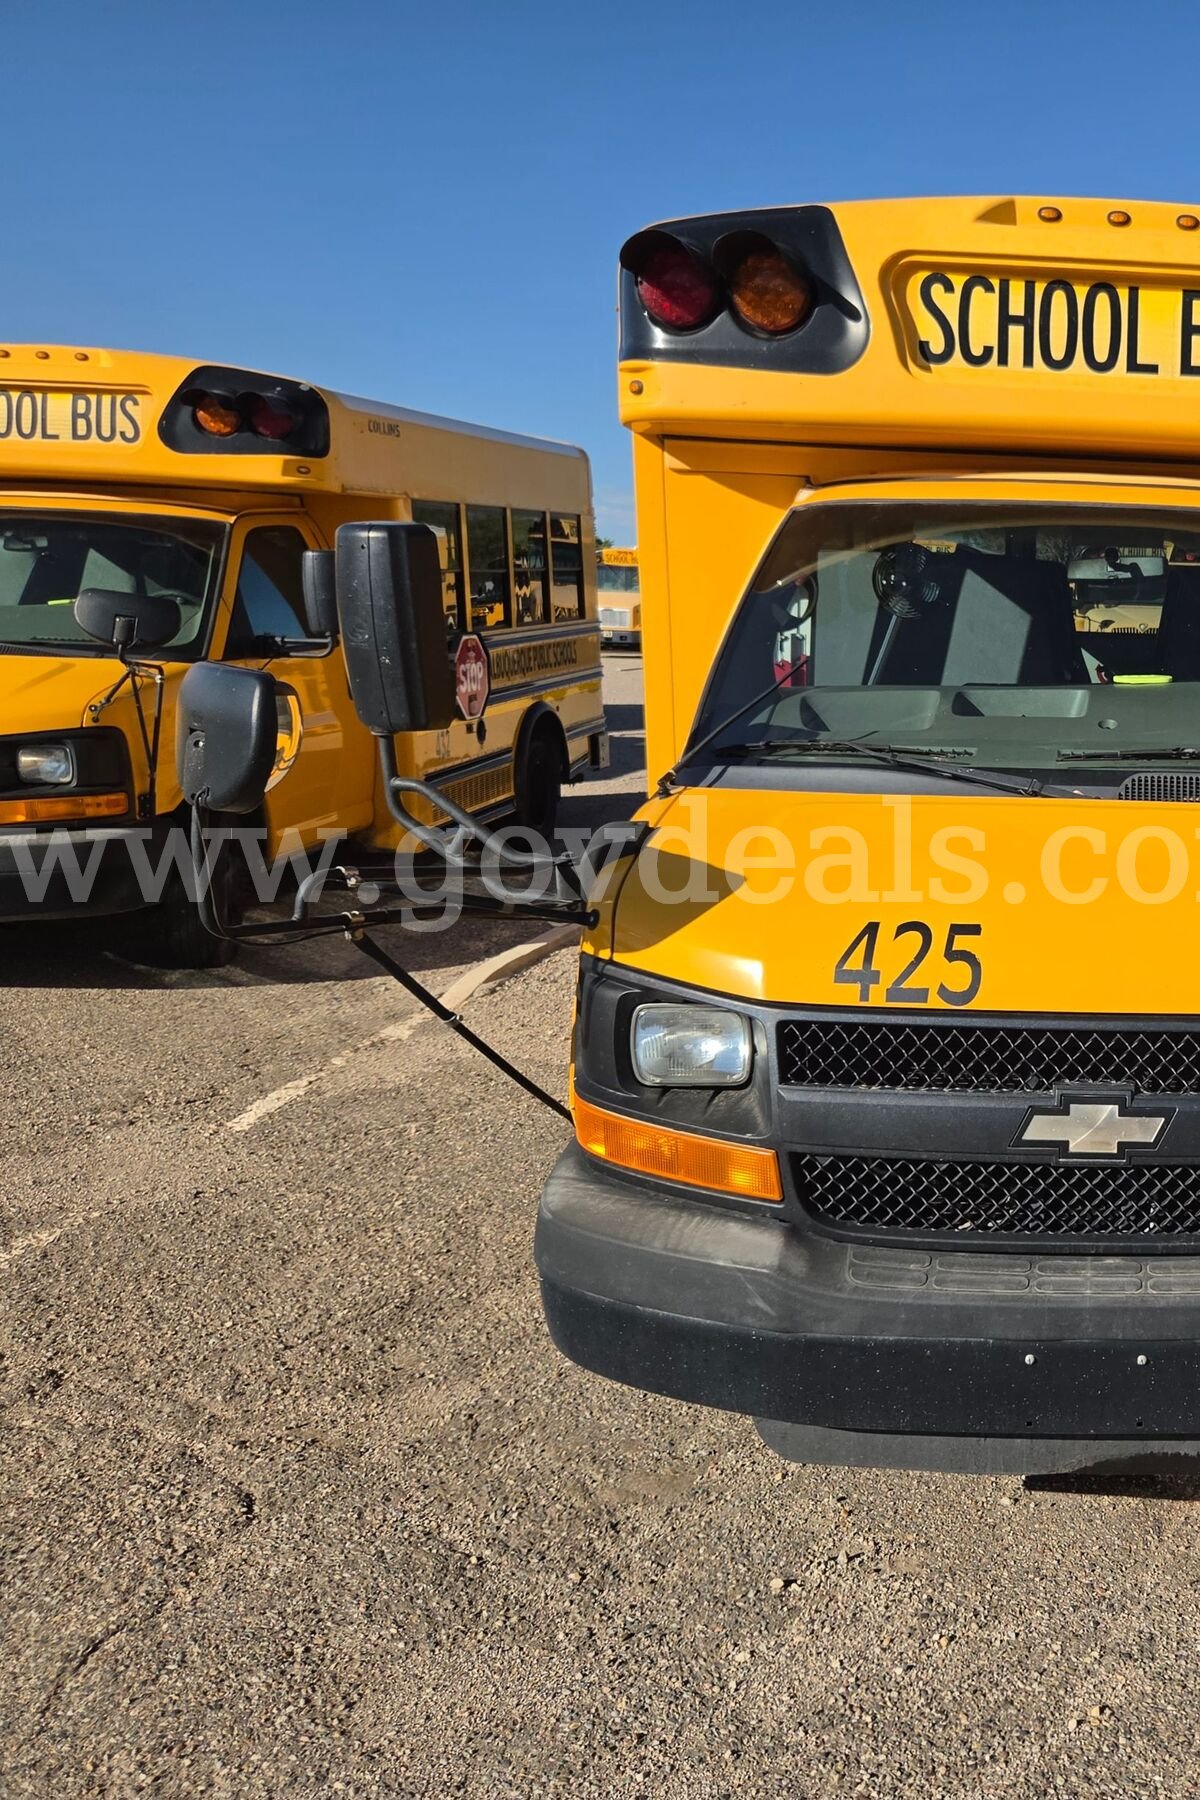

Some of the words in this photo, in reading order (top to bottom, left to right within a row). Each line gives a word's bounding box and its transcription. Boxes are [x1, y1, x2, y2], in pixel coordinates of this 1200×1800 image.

[919, 272, 1159, 375] SCHOOL
[71, 392, 140, 443] BUS
[459, 661, 484, 693] STOP
[833, 920, 983, 1007] 425
